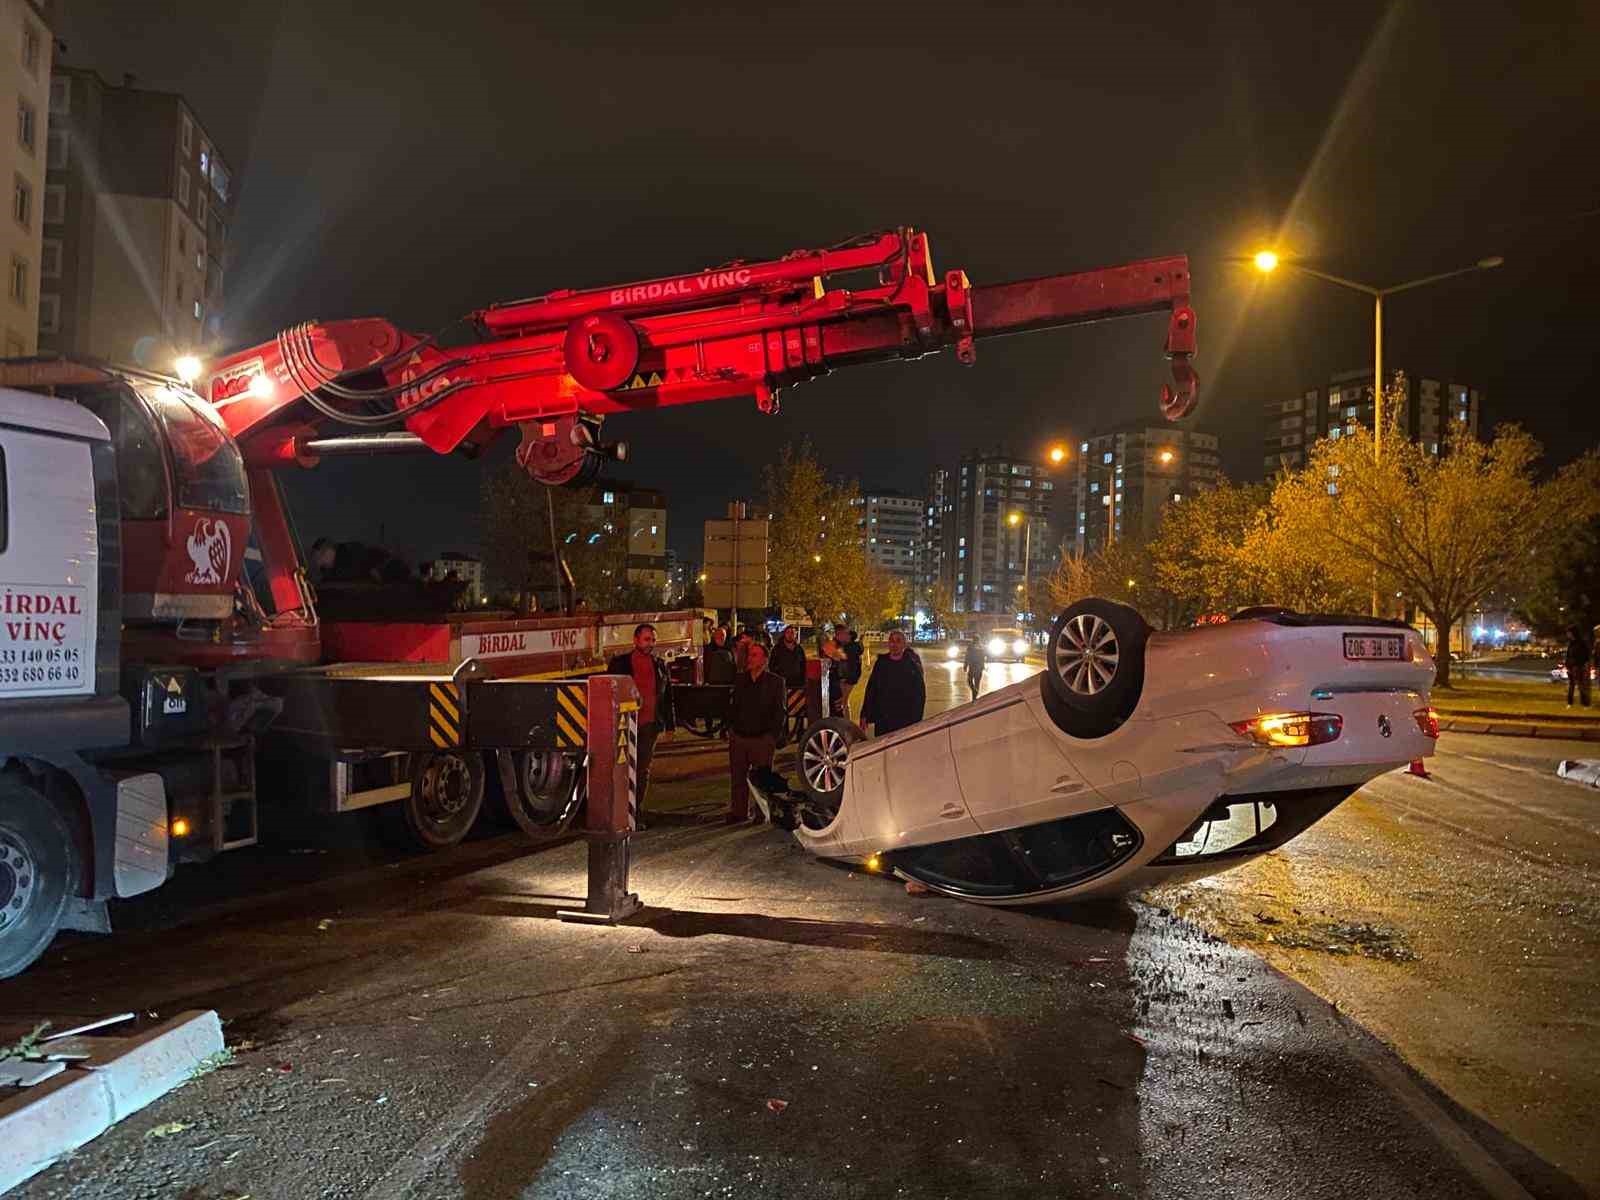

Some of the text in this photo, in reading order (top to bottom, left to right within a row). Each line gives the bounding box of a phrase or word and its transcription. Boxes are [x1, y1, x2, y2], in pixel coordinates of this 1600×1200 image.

[0, 588, 81, 614] İRDAL
[6, 617, 66, 646] VİNÇ
[22, 648, 42, 663] 140
[46, 648, 61, 662] 05
[65, 648, 78, 662] 05
[23, 667, 44, 682] 680
[48, 666, 62, 681] 66
[65, 665, 79, 680] 40
